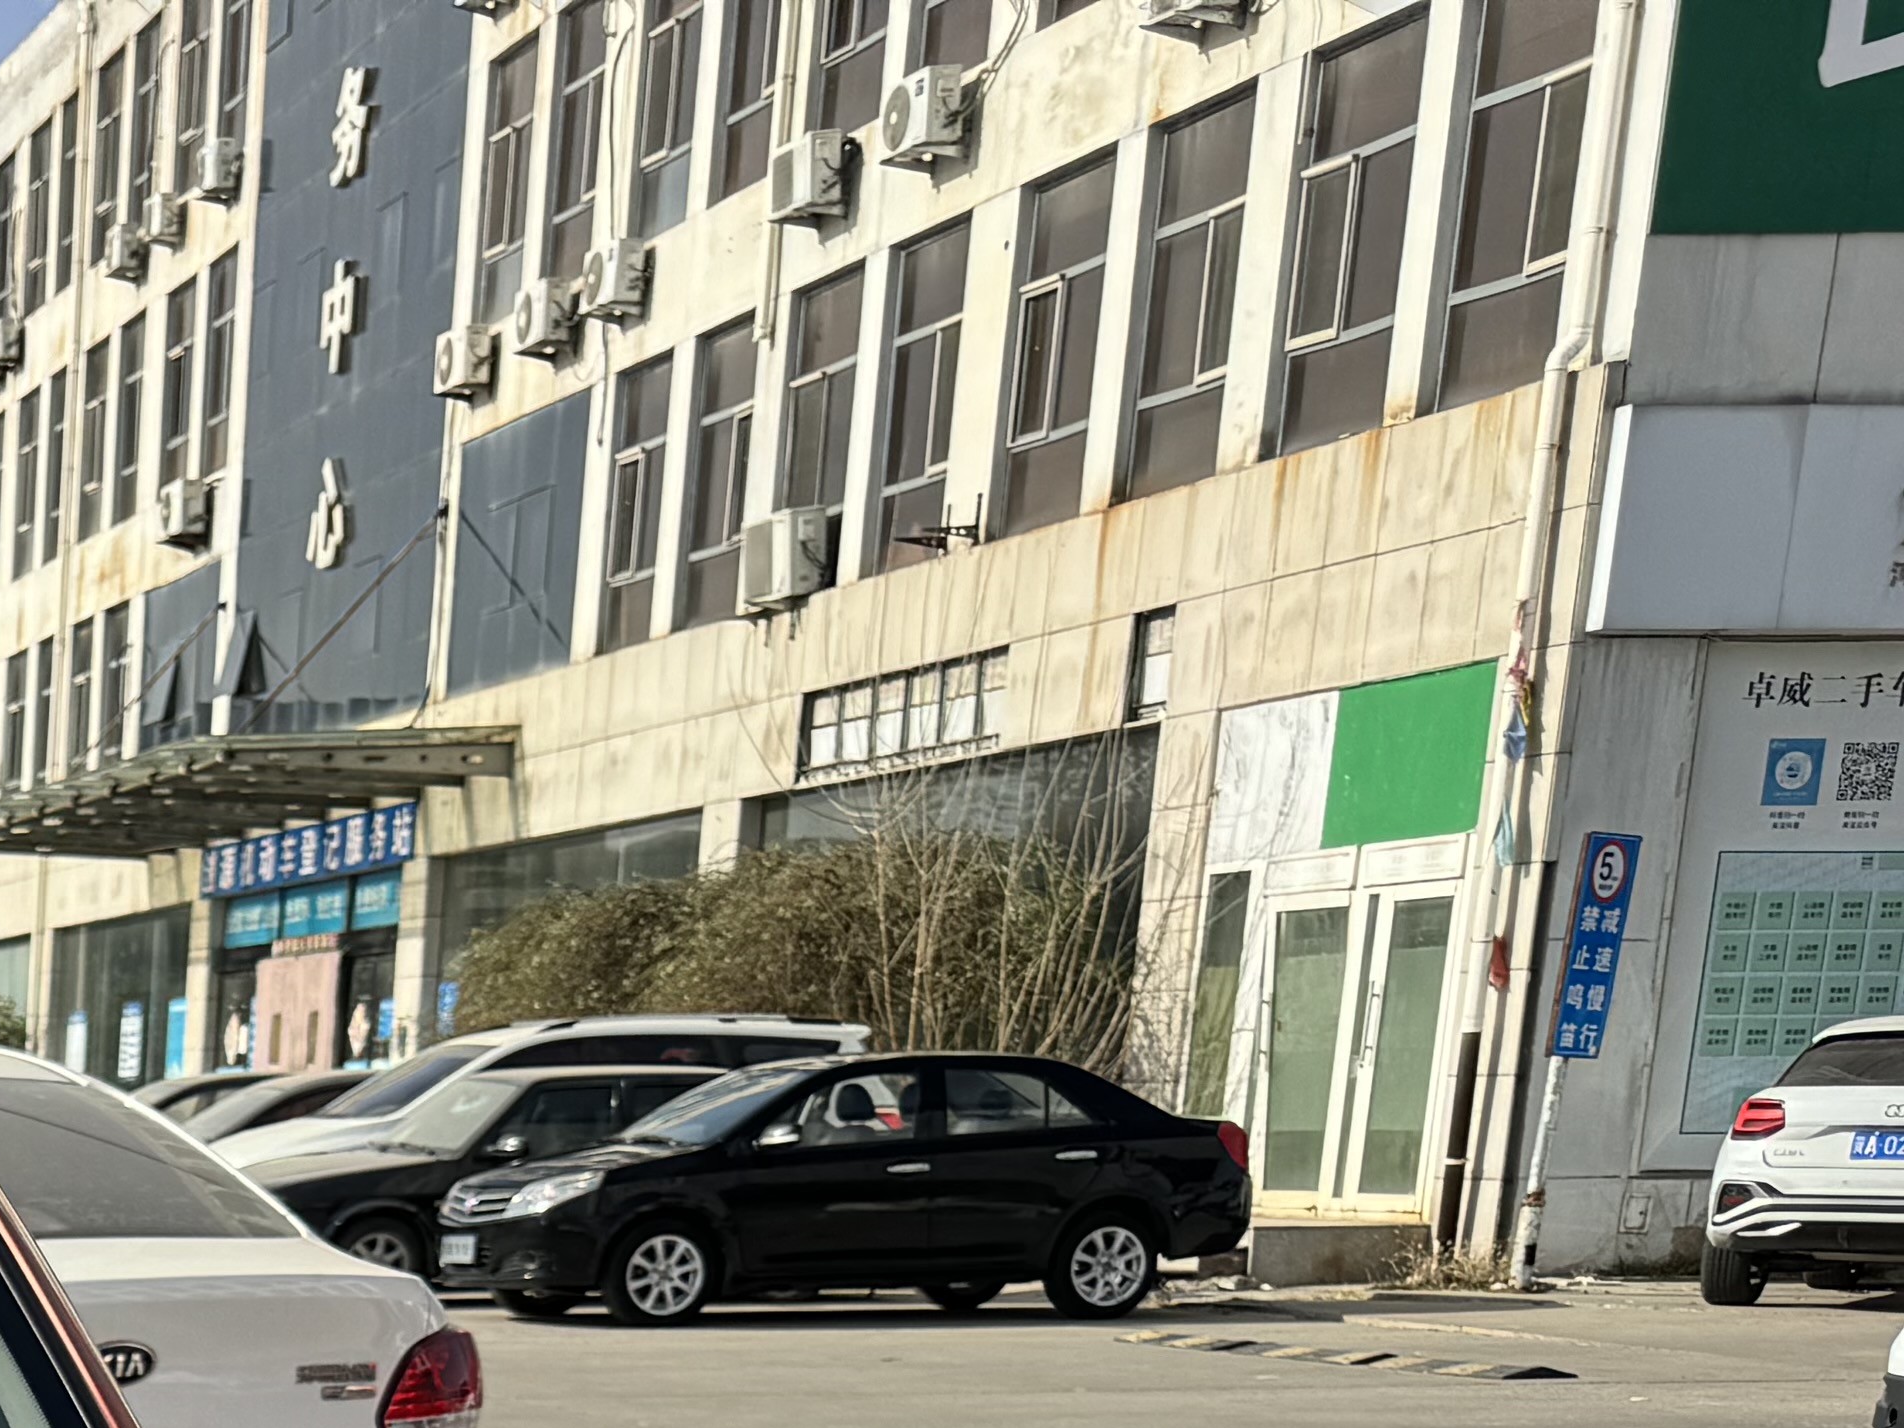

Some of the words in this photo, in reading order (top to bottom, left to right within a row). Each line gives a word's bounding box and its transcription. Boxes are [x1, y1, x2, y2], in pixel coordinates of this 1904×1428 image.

[1599, 851, 1615, 881] 5
[1559, 905, 1601, 1049] 禁止鸣笛
[1579, 907, 1622, 1051] 减速慢行
